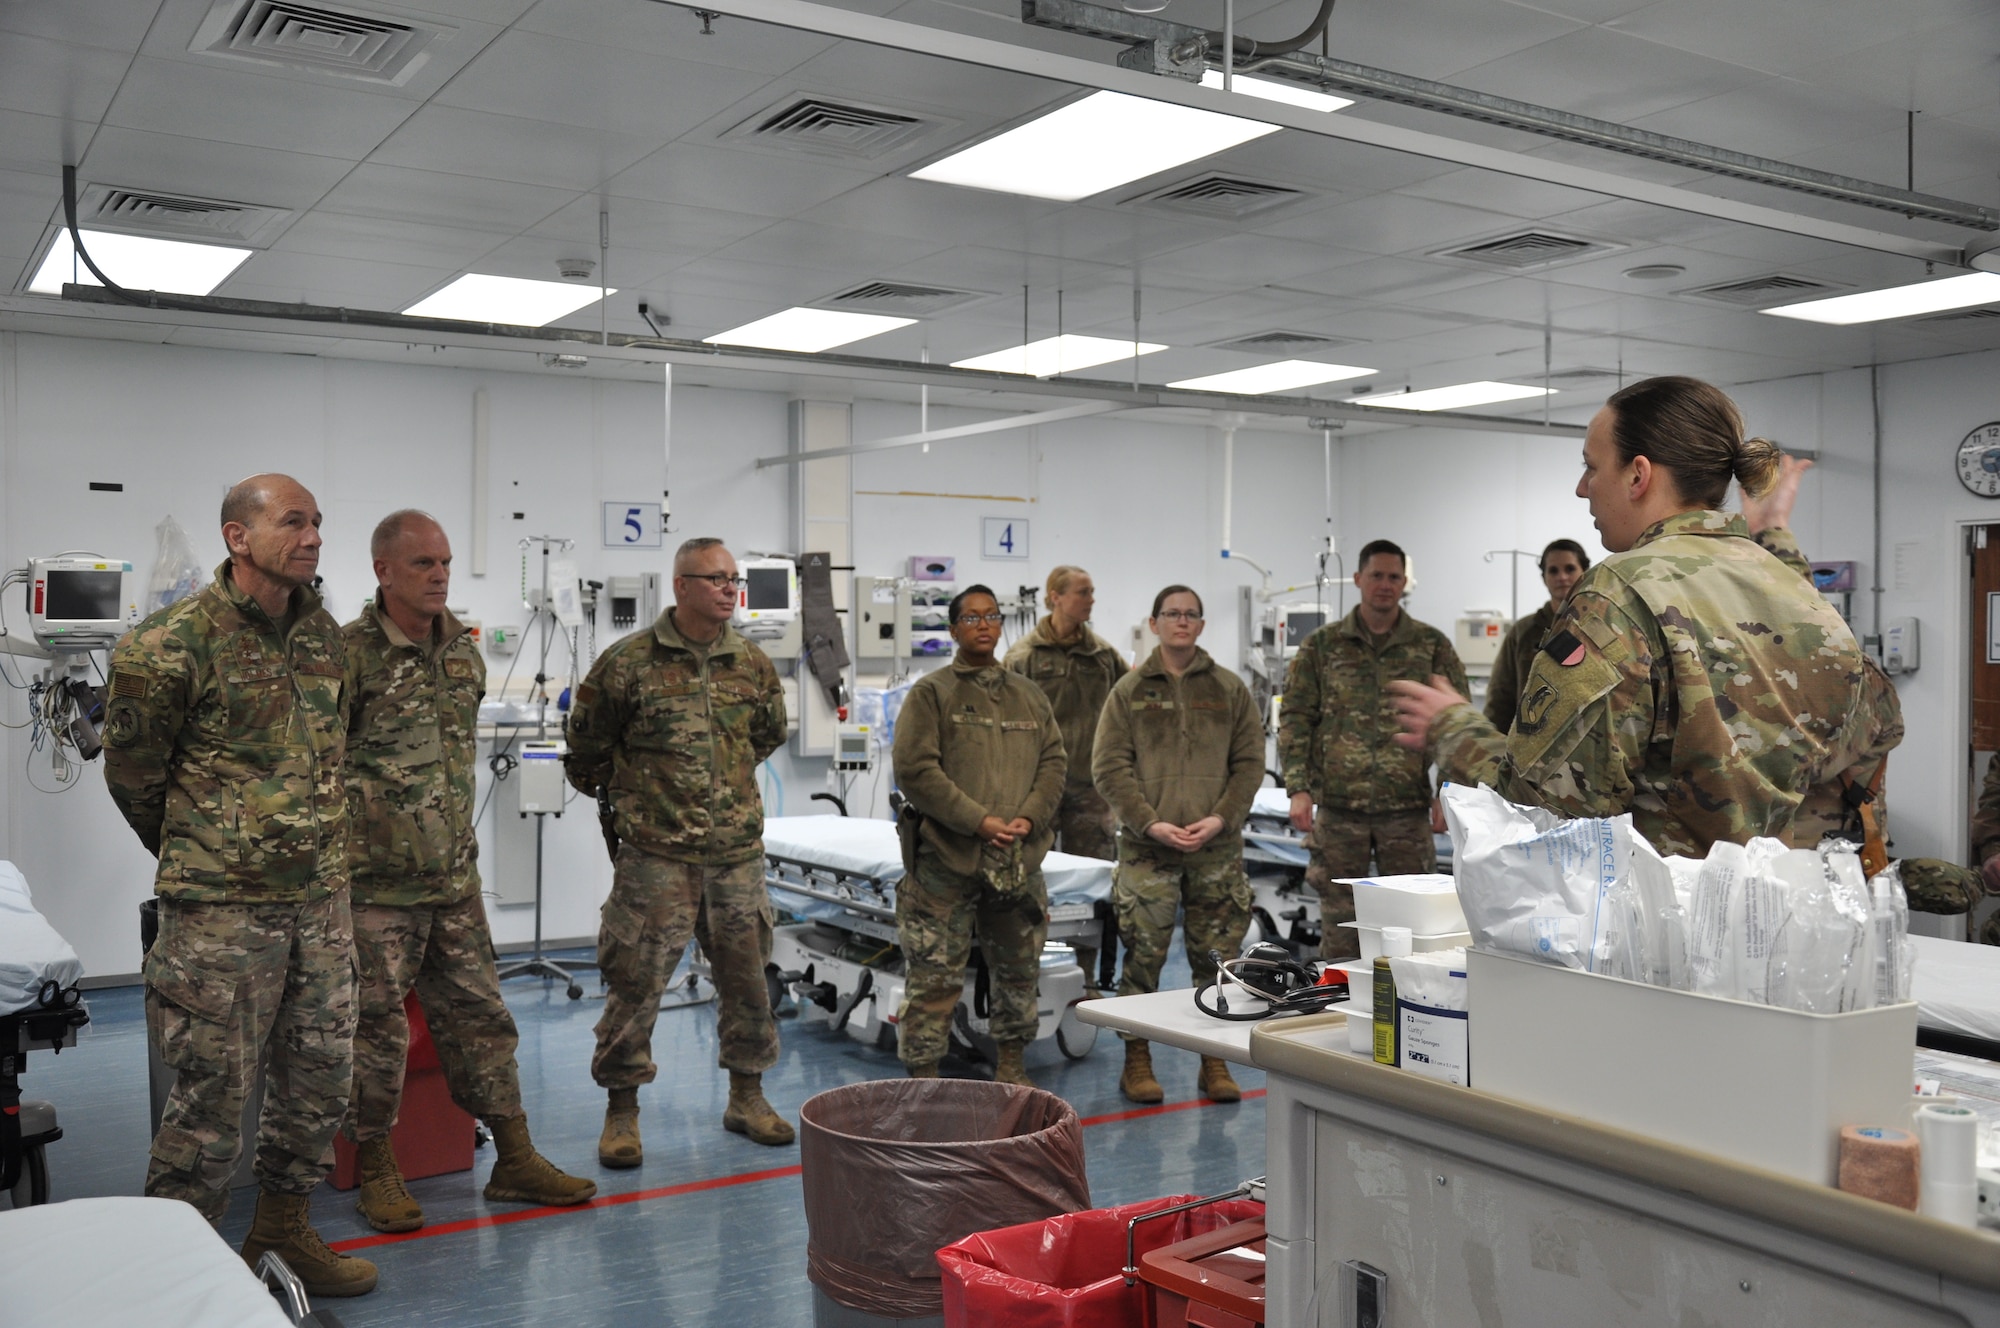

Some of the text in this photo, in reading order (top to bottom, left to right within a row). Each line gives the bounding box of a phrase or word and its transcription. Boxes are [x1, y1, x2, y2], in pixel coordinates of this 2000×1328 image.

[1987, 427, 1999, 437] 12
[1972, 434, 1982, 443] 11
[1961, 458, 1968, 468] 9
[1964, 471, 1971, 481] 8
[1975, 481, 1982, 490] 7
[1989, 483, 1996, 493] 6
[624, 508, 642, 542] 5
[999, 522, 1014, 553] 4
[1421, 1038, 1440, 1047] Sponges
